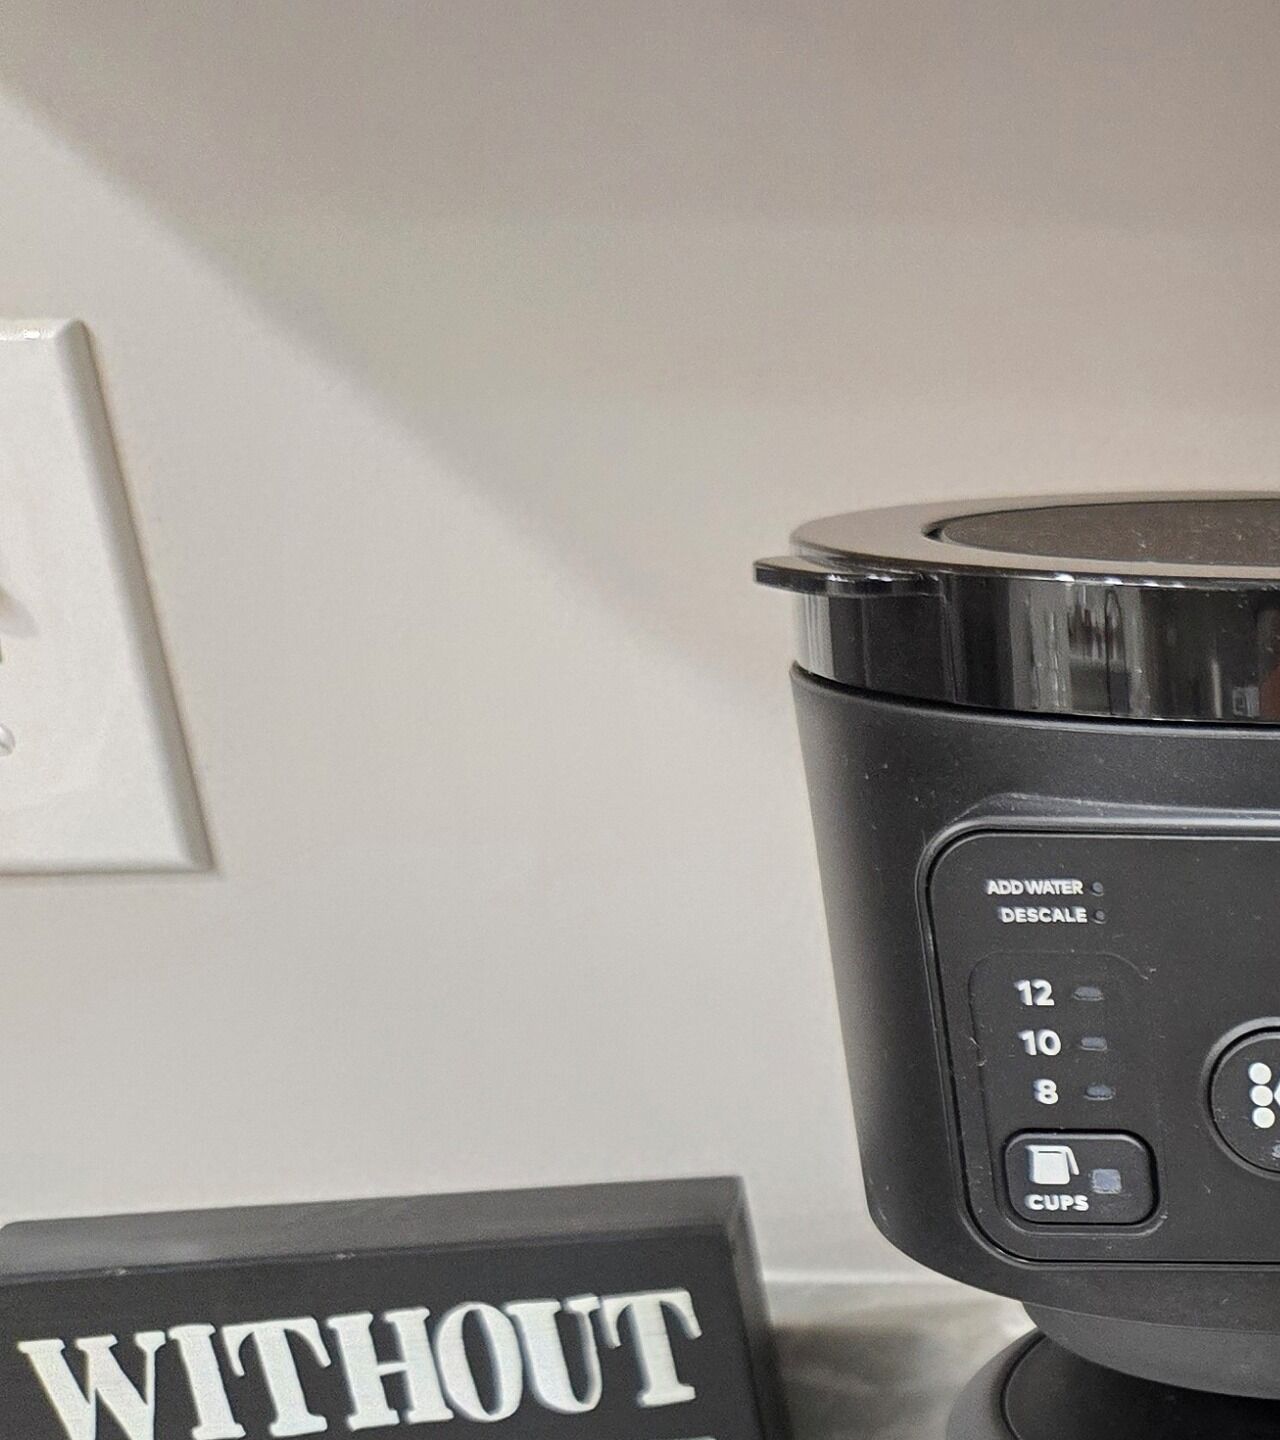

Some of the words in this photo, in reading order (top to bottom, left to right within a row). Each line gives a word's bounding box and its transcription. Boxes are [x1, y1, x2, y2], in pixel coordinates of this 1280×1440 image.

[985, 879, 1024, 895] ADD
[1023, 879, 1084, 895] WATER
[1000, 906, 1089, 923] DESCALE
[1014, 978, 1055, 1006] 12
[1018, 1028, 1062, 1056] 10
[1033, 1078, 1059, 1105] 8
[1024, 1194, 1090, 1212] CUPS
